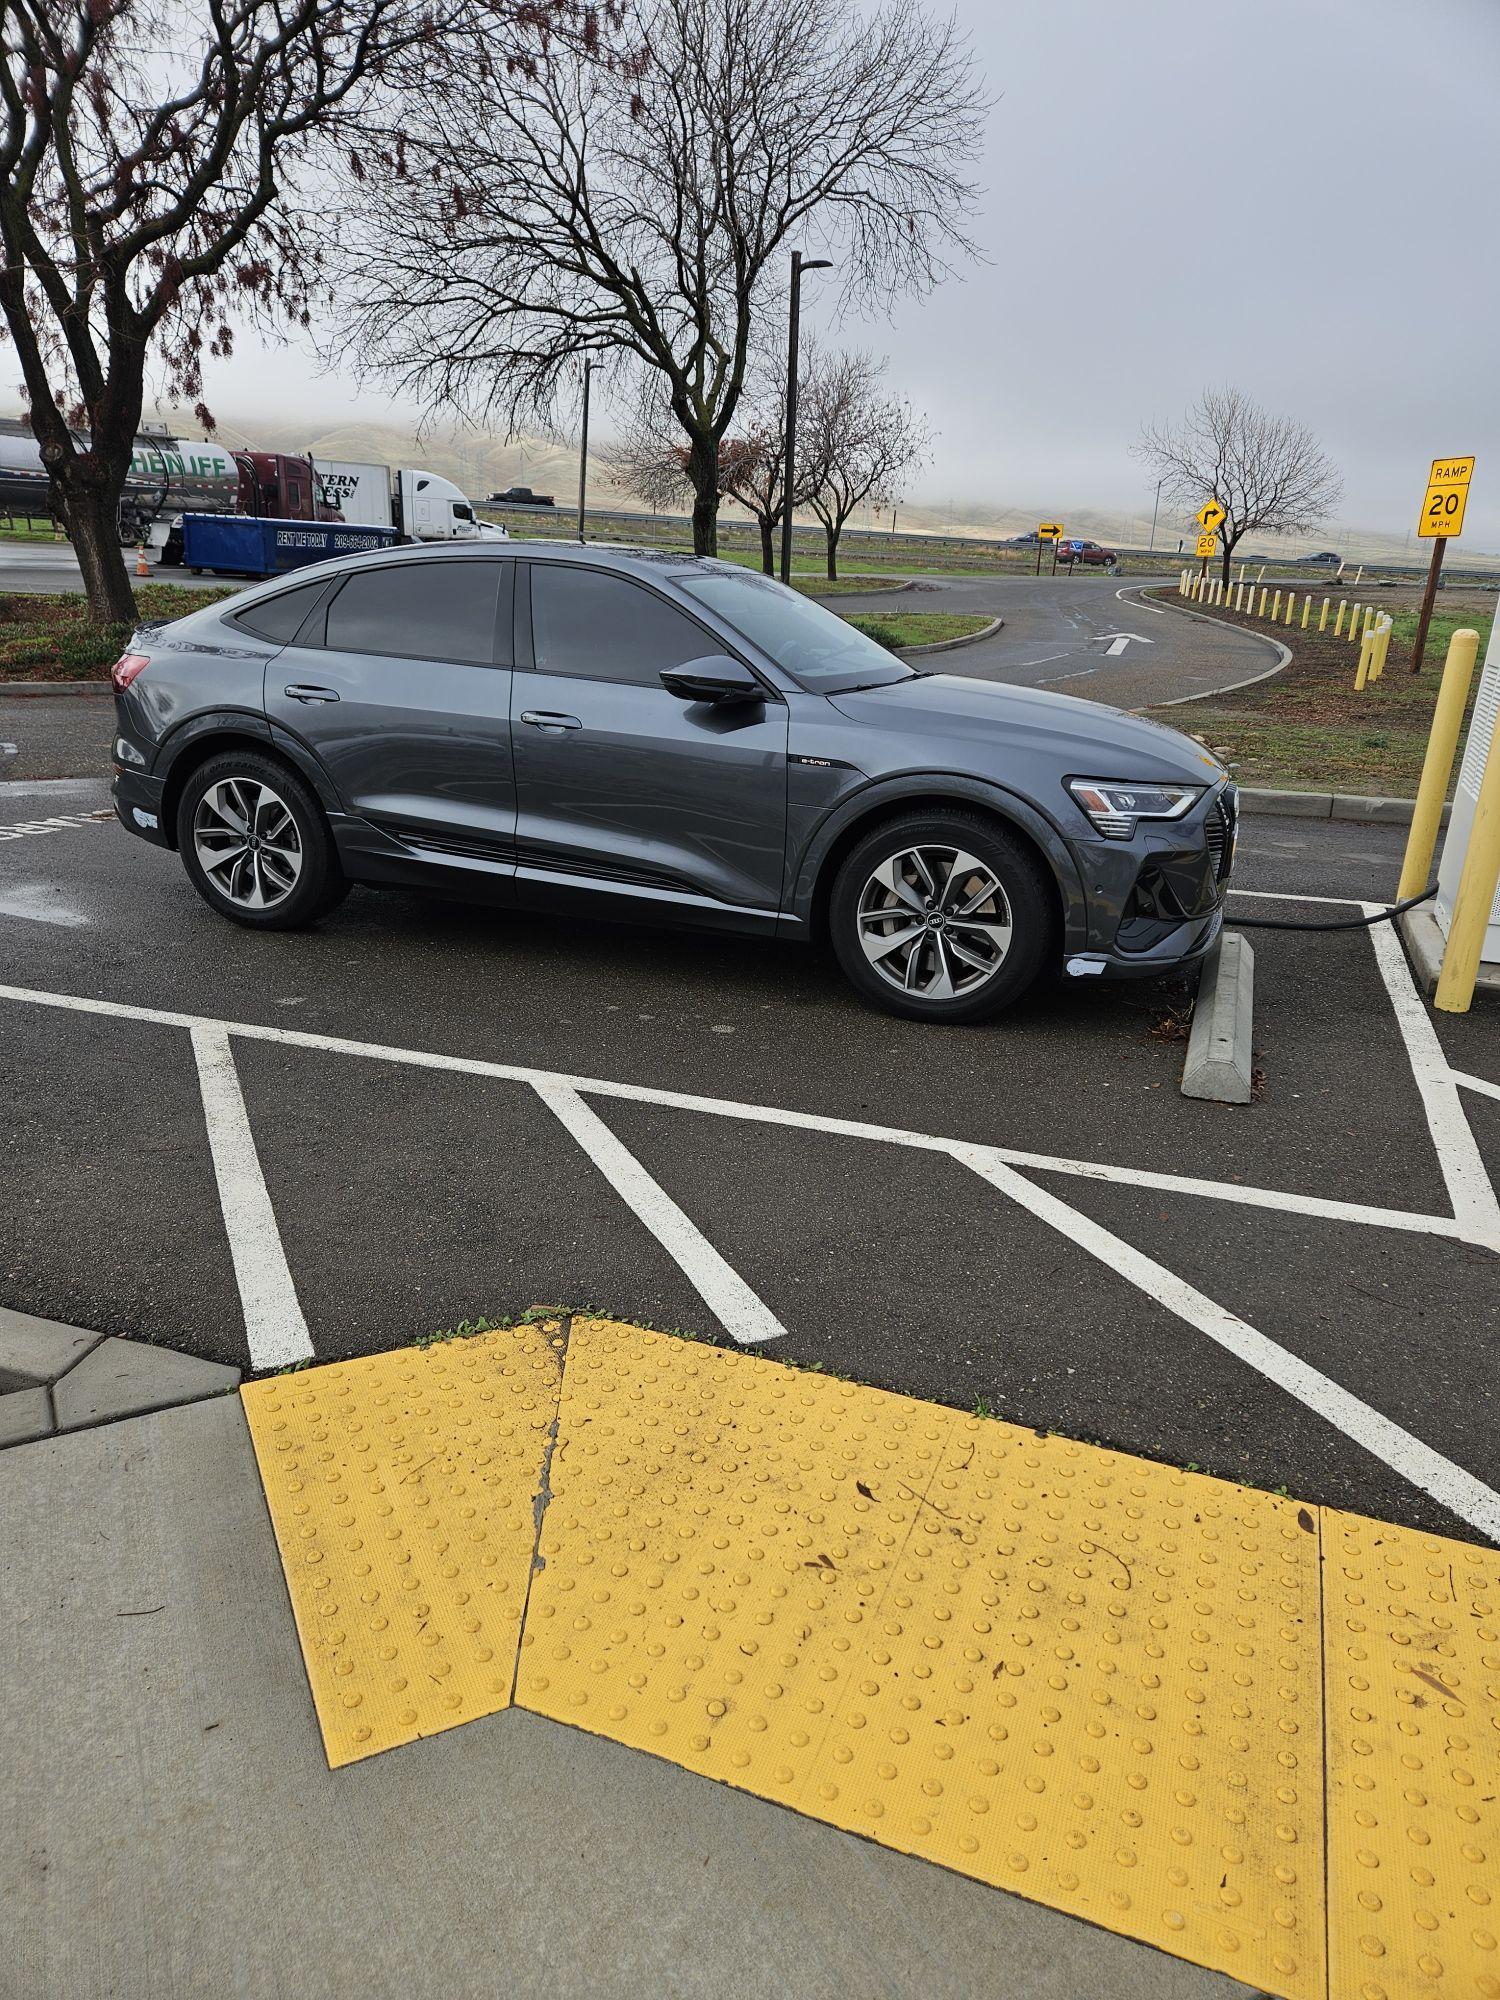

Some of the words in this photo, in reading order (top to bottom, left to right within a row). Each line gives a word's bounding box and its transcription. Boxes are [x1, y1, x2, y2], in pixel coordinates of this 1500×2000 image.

[1435, 465, 1467, 479] RAMP
[320, 473, 360, 487] TERN
[1428, 493, 1459, 516] 20
[1431, 520, 1451, 529] MPH
[276, 530, 296, 546] RENT
[295, 531, 307, 547] ME
[306, 532, 328, 548] TODAY
[1199, 537, 1215, 548] 20
[801, 758, 830, 766] e-tron
